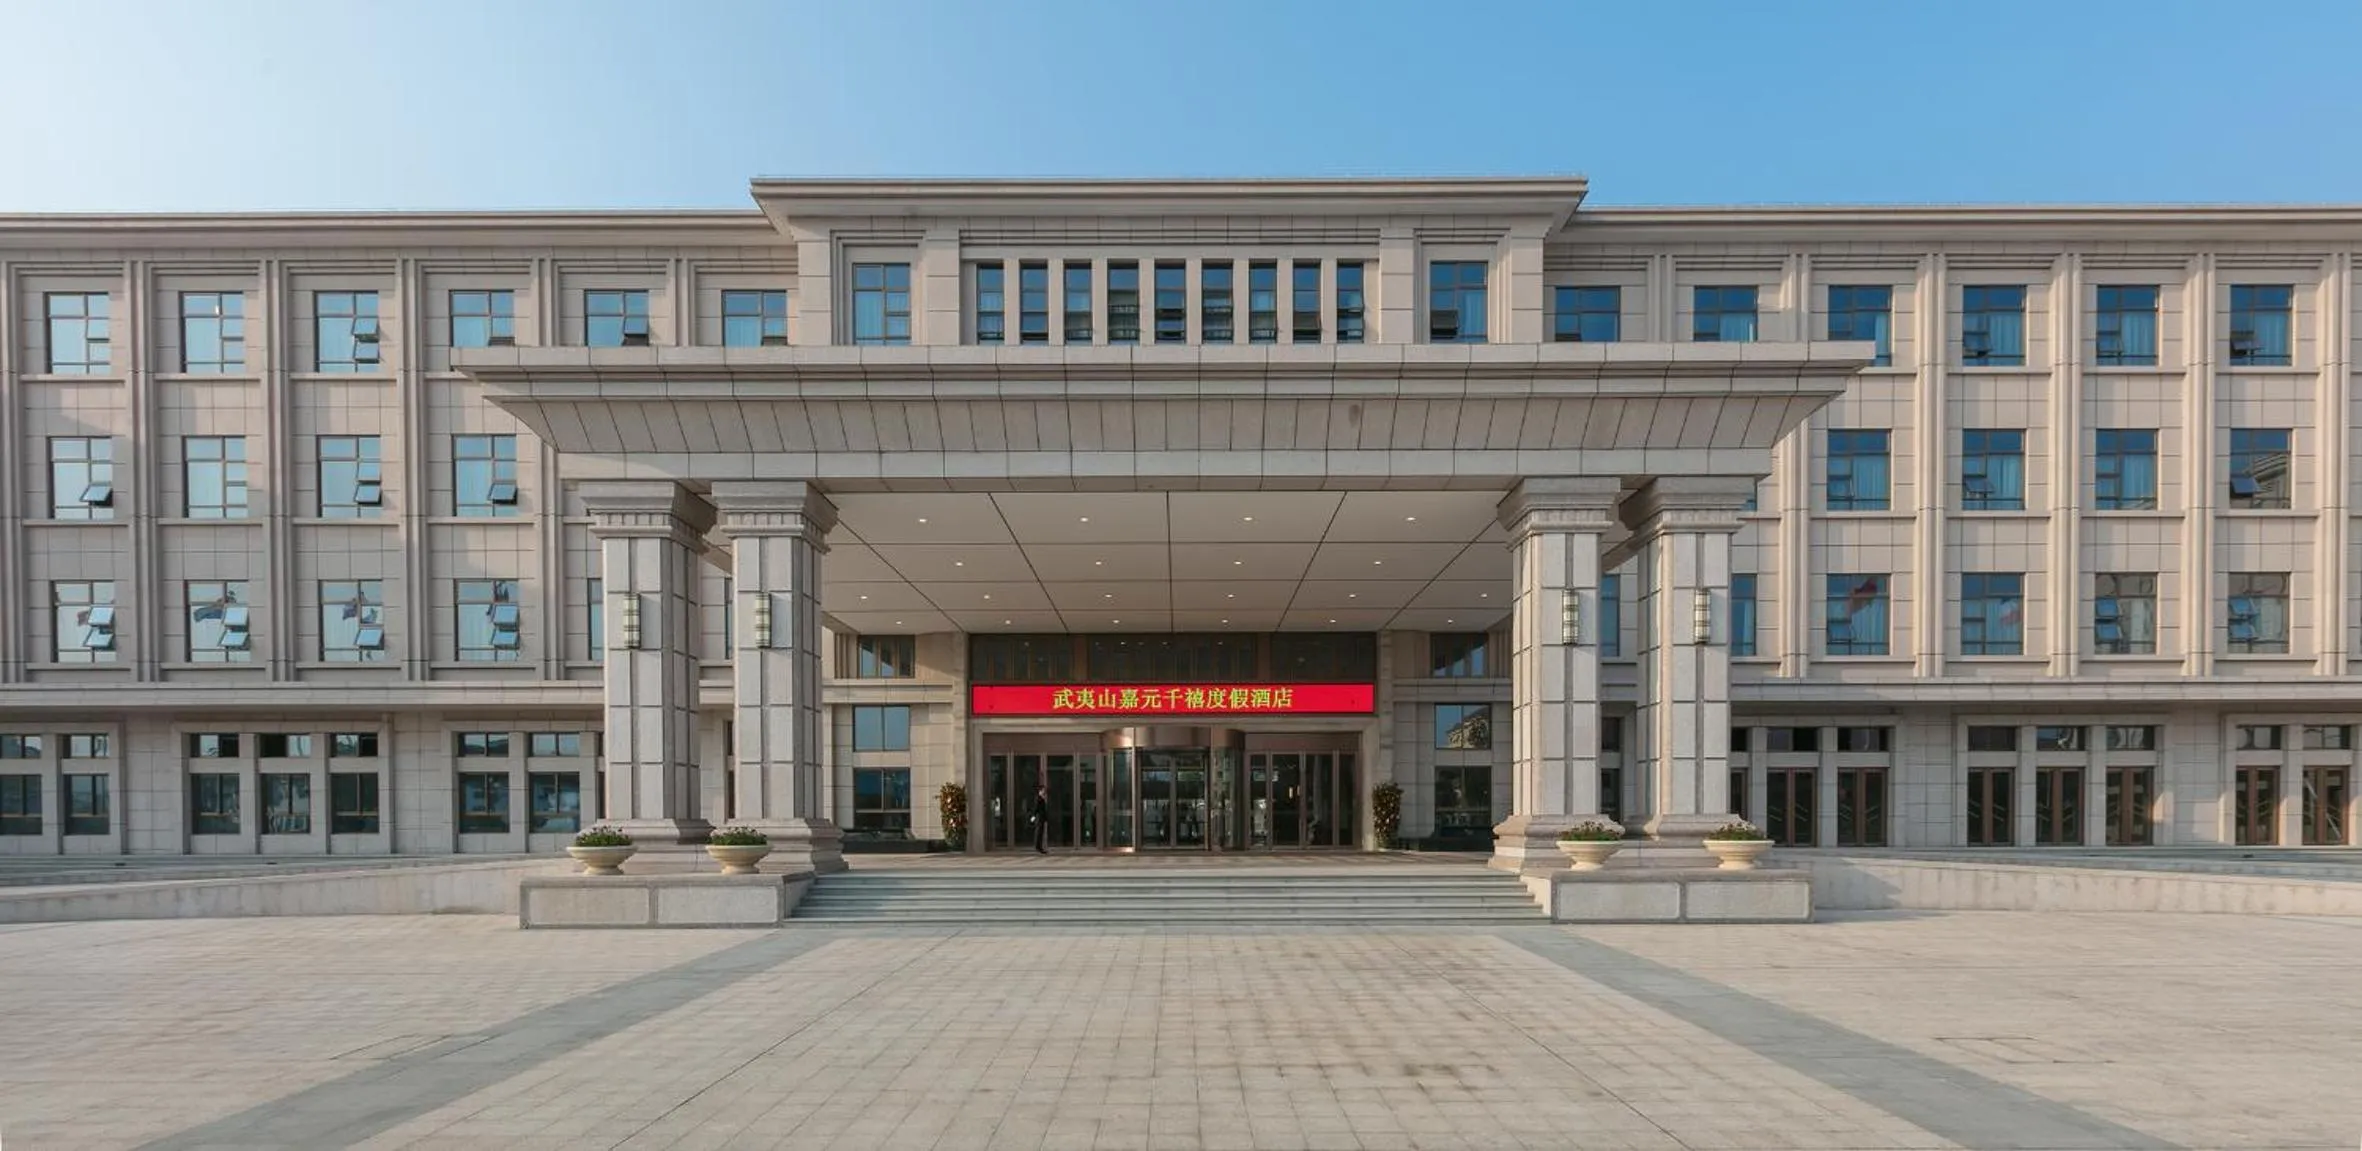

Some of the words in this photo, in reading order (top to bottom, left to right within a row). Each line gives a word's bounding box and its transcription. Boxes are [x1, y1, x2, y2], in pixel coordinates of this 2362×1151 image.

[1052, 688, 1293, 709] 武夷山嘉元千禧度假酒店
